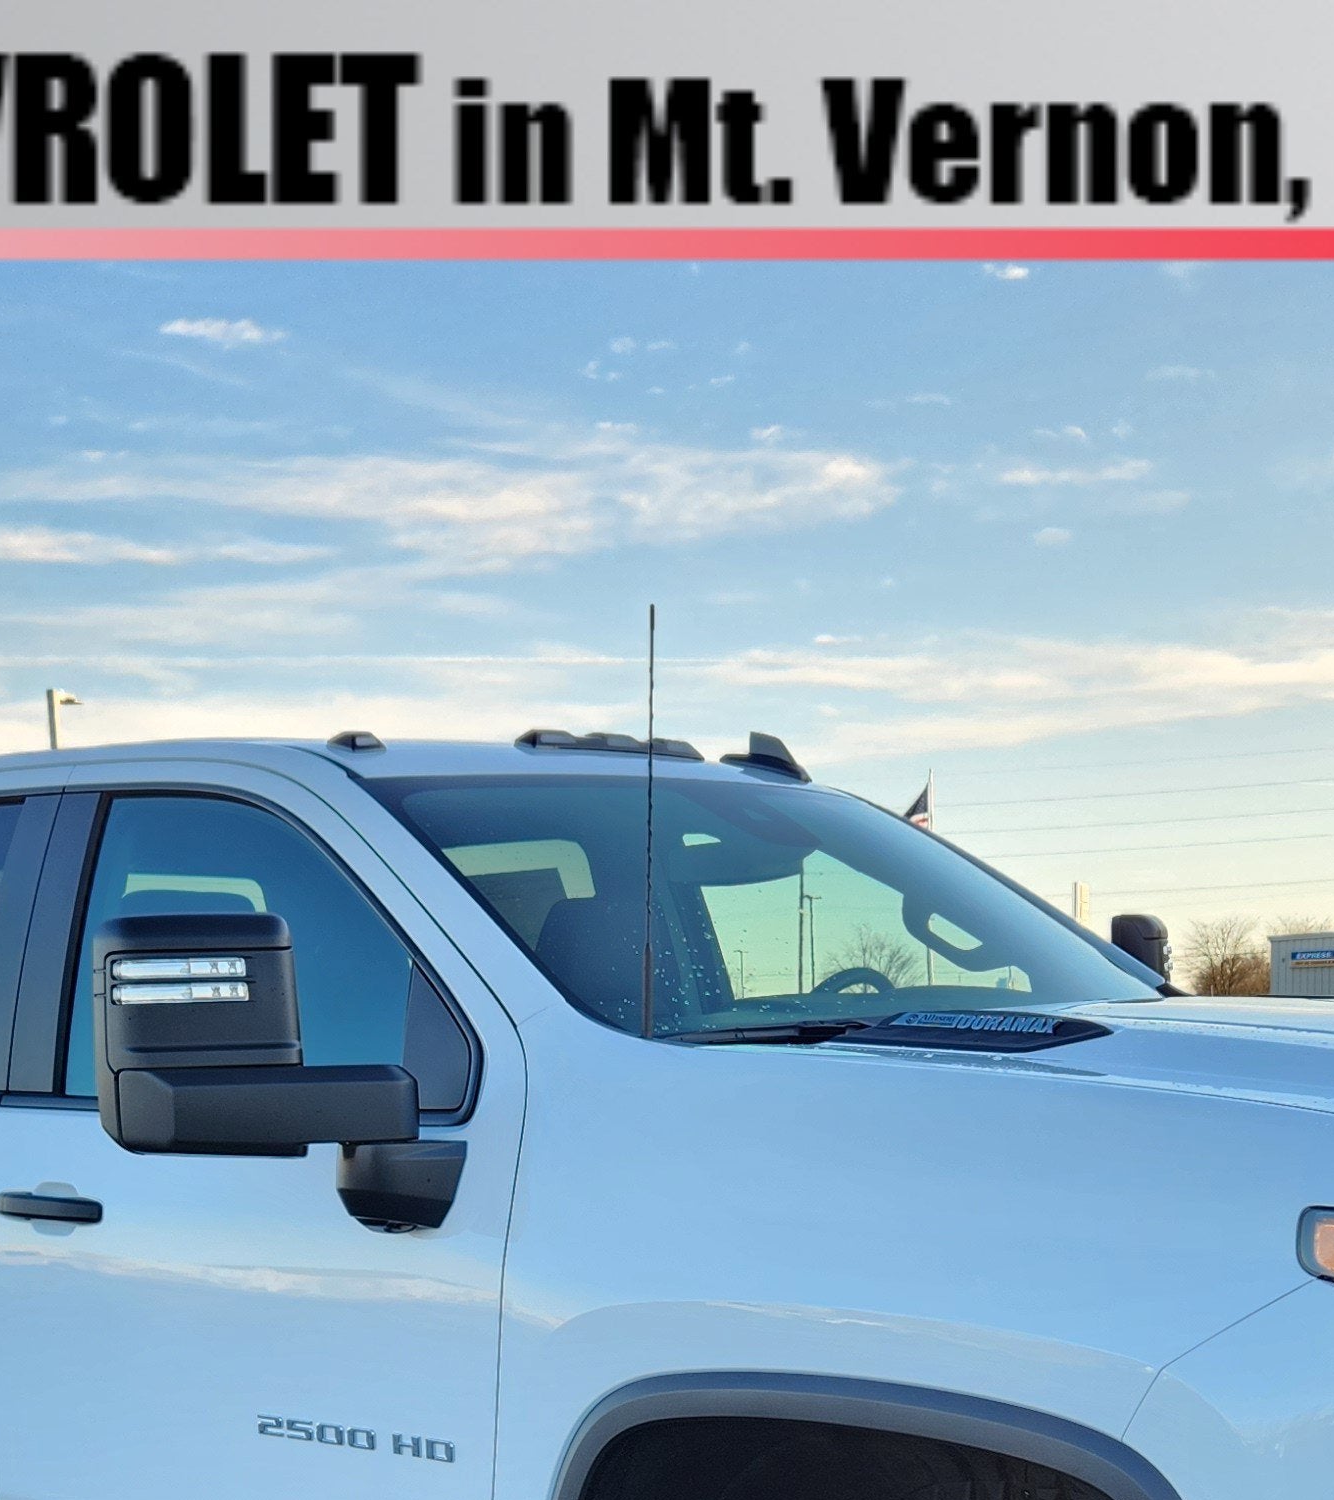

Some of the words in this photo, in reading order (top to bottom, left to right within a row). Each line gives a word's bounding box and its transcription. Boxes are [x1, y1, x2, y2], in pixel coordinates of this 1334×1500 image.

[919, 1013, 956, 1025] Allison
[956, 1013, 1063, 1034] DURAMAX
[256, 1412, 377, 1452] 2500
[391, 1431, 456, 1464] HD
